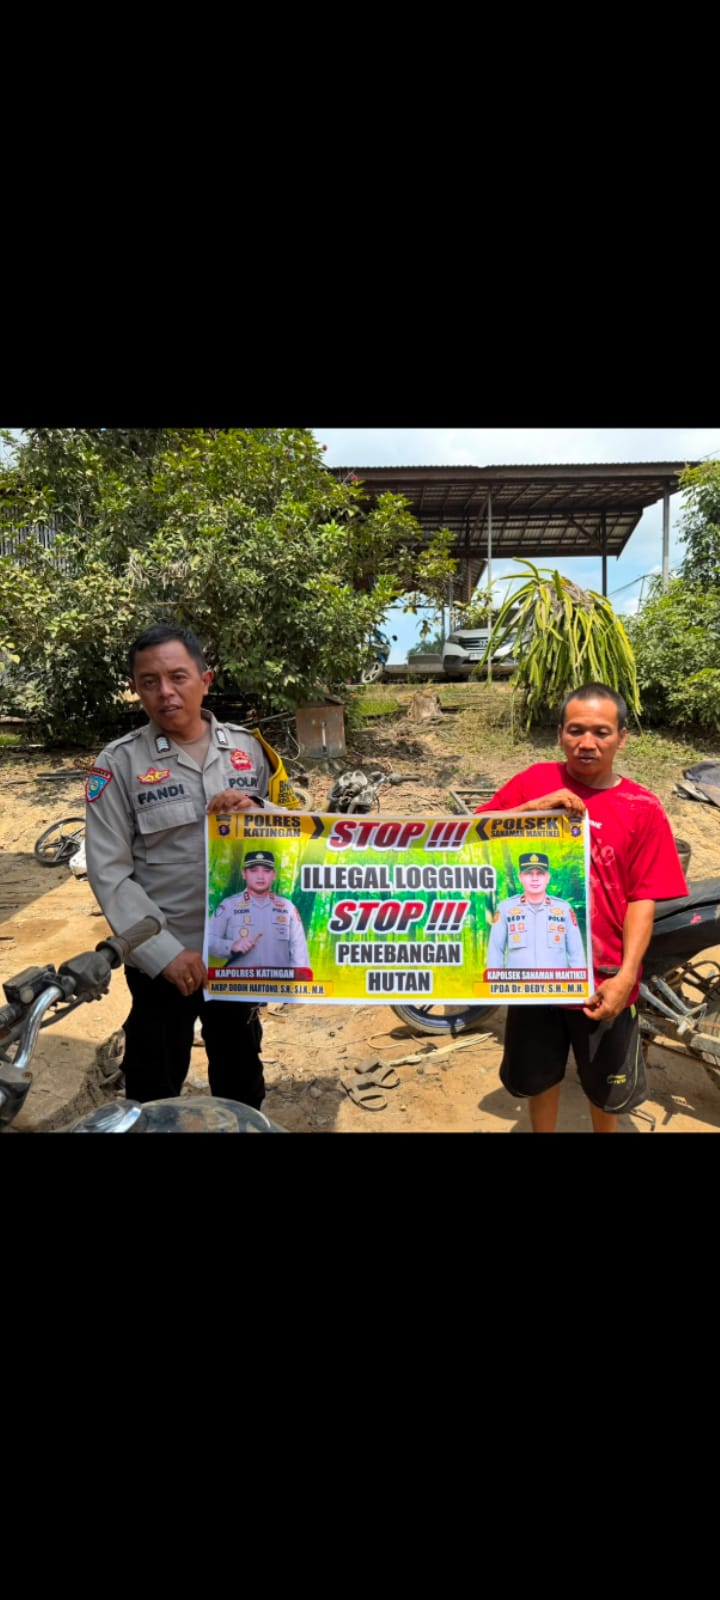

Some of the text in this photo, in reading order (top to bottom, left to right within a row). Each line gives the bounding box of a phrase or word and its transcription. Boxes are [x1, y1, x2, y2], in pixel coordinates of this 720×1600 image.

[137, 784, 185, 804] FANDI
[243, 814, 301, 828] POLRES
[491, 817, 558, 830] POLSEK
[243, 828, 301, 838] KATINGAN
[329, 820, 471, 849] STOP !!!
[303, 866, 495, 890] ILLEGAL LOGGING
[329, 901, 469, 932] STOP !!!
[337, 943, 461, 964] PENEBANGAN
[215, 968, 295, 979] KAPOLRES KATINGAN
[367, 971, 431, 992] HUTAN
[491, 984, 510, 993] IPDA
